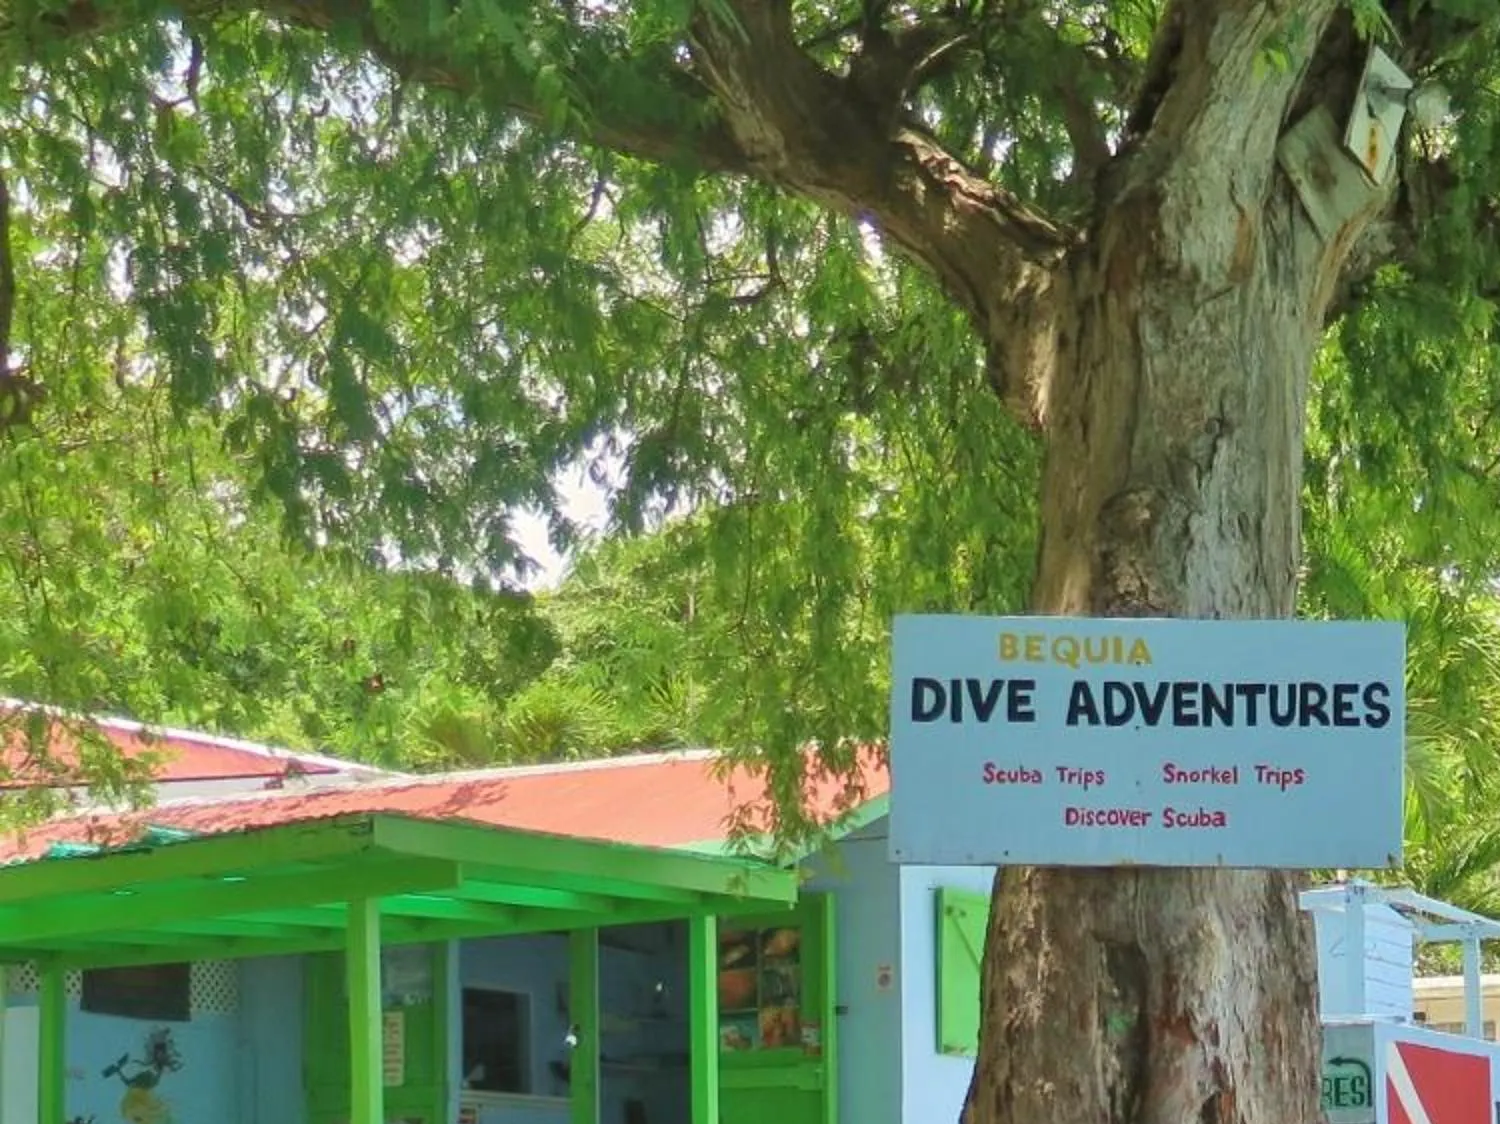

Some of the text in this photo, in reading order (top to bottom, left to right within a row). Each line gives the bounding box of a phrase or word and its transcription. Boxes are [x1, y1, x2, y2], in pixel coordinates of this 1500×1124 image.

[998, 632, 1152, 668] BEQUIA
[911, 677, 1391, 728] DIVE ADVENTURES
[982, 762, 1305, 791] Scuba Trips Snorkel Trips
[1064, 807, 1226, 828] Discover Scuba
